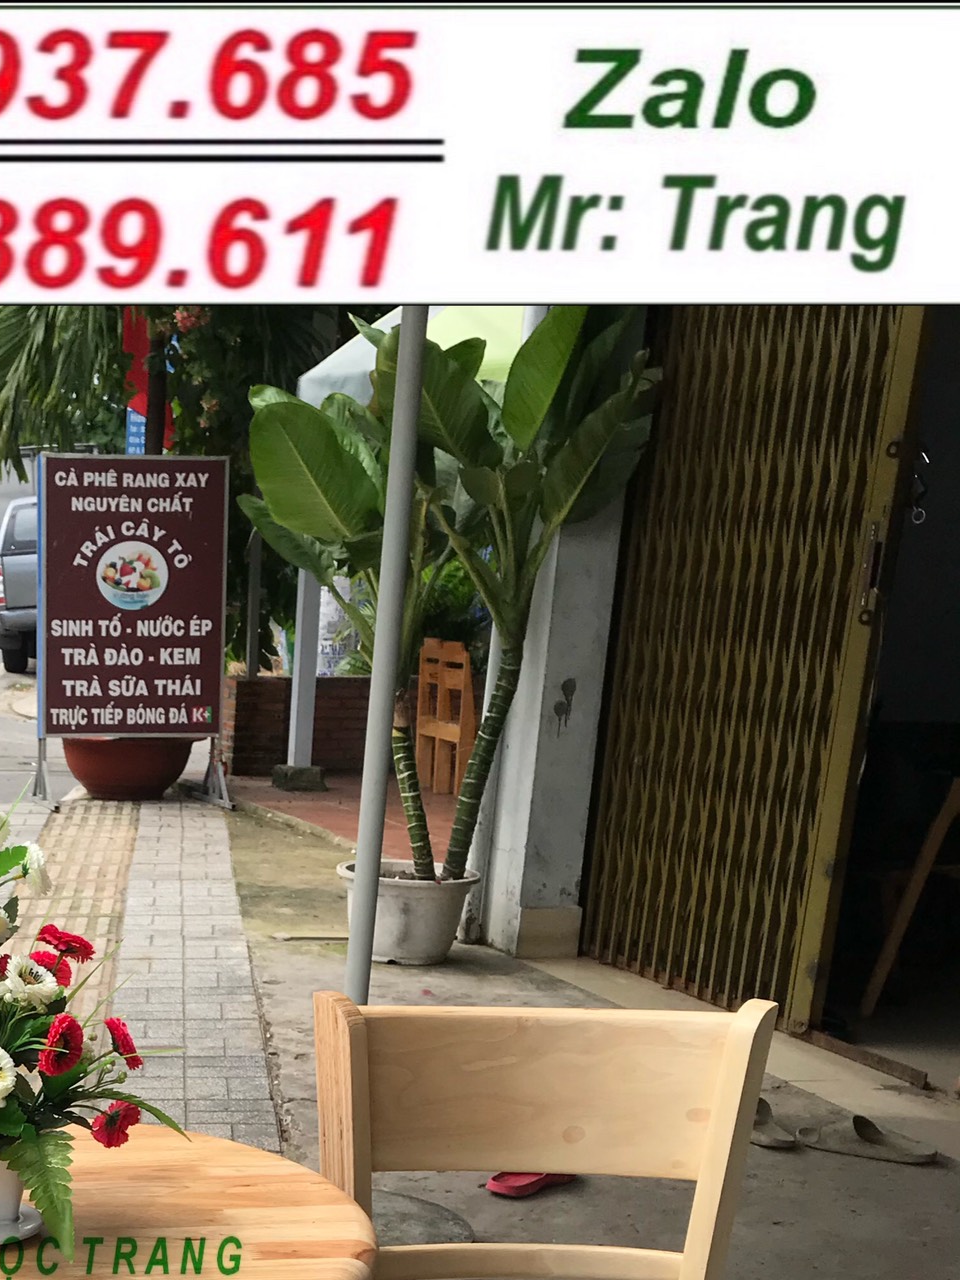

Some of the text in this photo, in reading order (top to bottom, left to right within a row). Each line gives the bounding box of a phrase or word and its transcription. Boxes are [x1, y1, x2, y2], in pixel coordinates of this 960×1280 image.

[54, 468, 209, 488] CÀ PHÊ RANG XAY
[71, 491, 193, 513] NGUYÊN CHẤT
[72, 525, 116, 567] TRÁI
[121, 518, 167, 542] CÂY
[51, 619, 93, 637] SINH
[98, 612, 122, 637] TỐ
[136, 613, 185, 637] NƯỚC
[190, 614, 213, 636] ÉP
[61, 644, 100, 666] TRÀ
[104, 643, 144, 666] ĐÀO
[159, 648, 201, 665] KEM
[62, 674, 201, 697] TRÀ SỮA THÁI
[50, 706, 88, 730] TRỰC
[91, 701, 123, 725] TIẾP
[127, 703, 166, 725] BÓNG
[168, 702, 188, 724] ĐÁ
